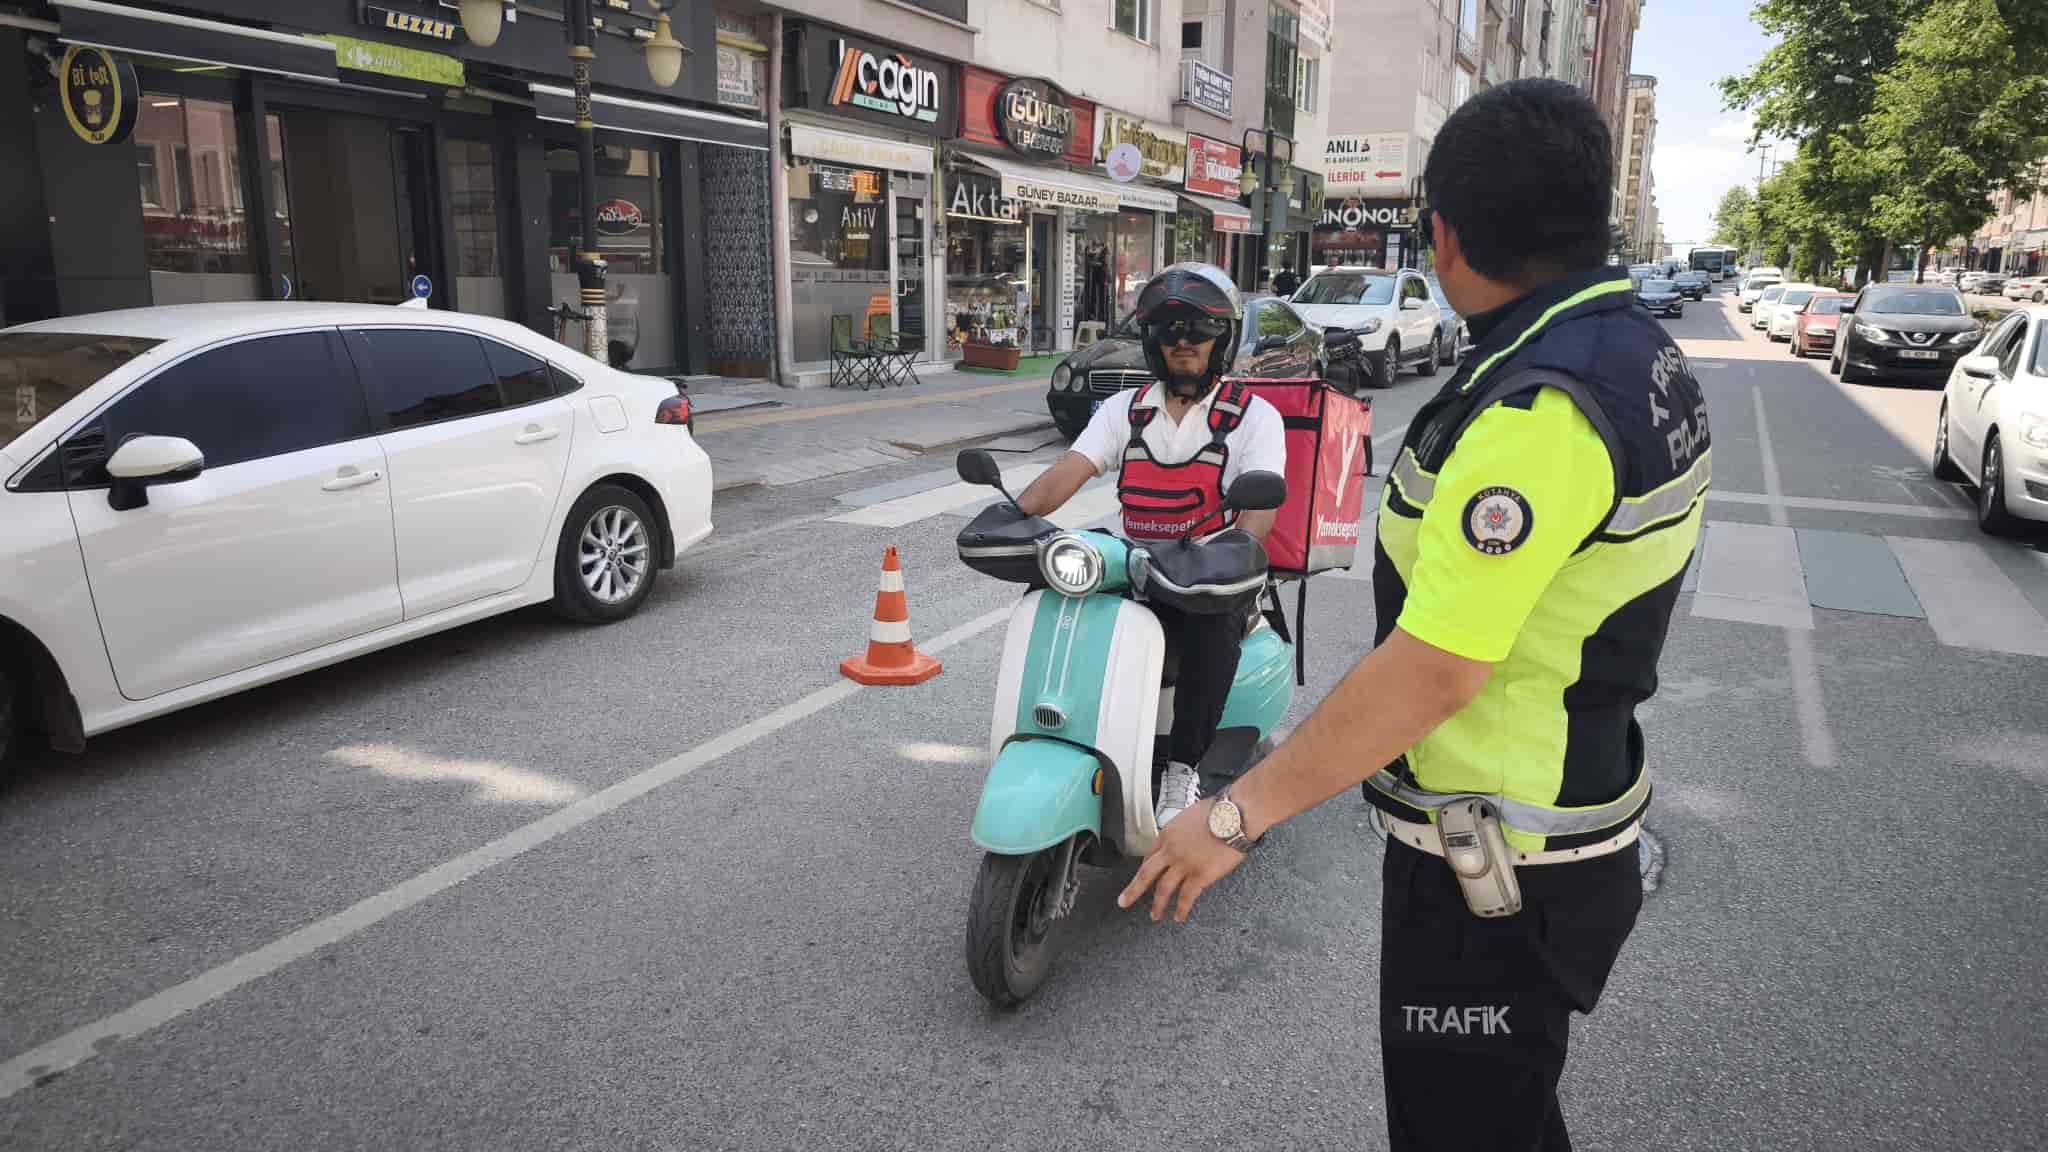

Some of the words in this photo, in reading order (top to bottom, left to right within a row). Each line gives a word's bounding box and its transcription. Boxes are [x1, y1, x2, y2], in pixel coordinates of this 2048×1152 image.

[385, 11, 455, 41] LEZZET
[1327, 168, 1367, 182] İLERİDE
[1017, 184, 1055, 202] GÜNEY
[1055, 190, 1099, 209] BAZAAR
[1400, 1005, 1513, 1035] TRAFİK
